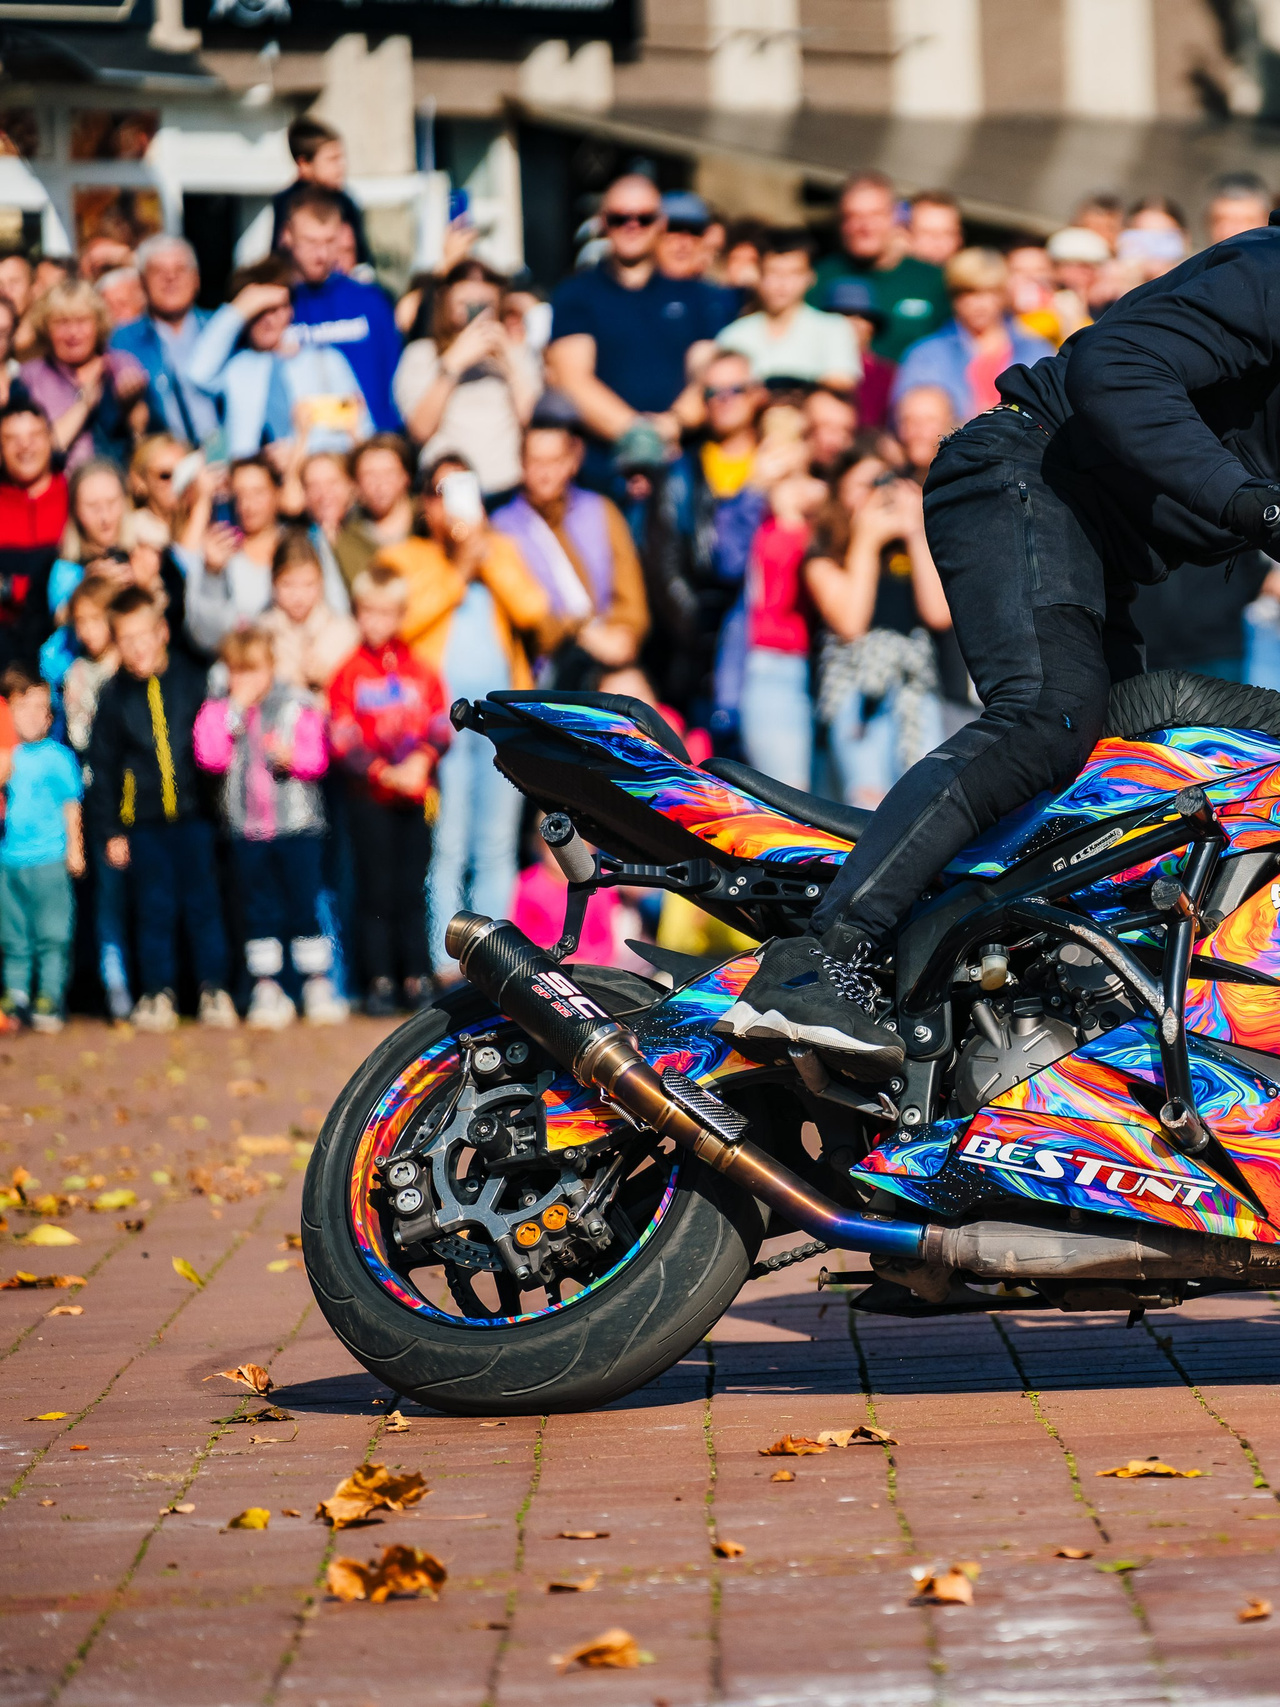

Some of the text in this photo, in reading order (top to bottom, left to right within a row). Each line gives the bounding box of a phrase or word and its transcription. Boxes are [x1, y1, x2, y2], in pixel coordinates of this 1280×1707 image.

[531, 975, 588, 1020] PROJECT
[531, 984, 573, 1018] GP M2
[537, 972, 609, 1019] SC
[958, 1134, 1217, 1207] BESTUNT
